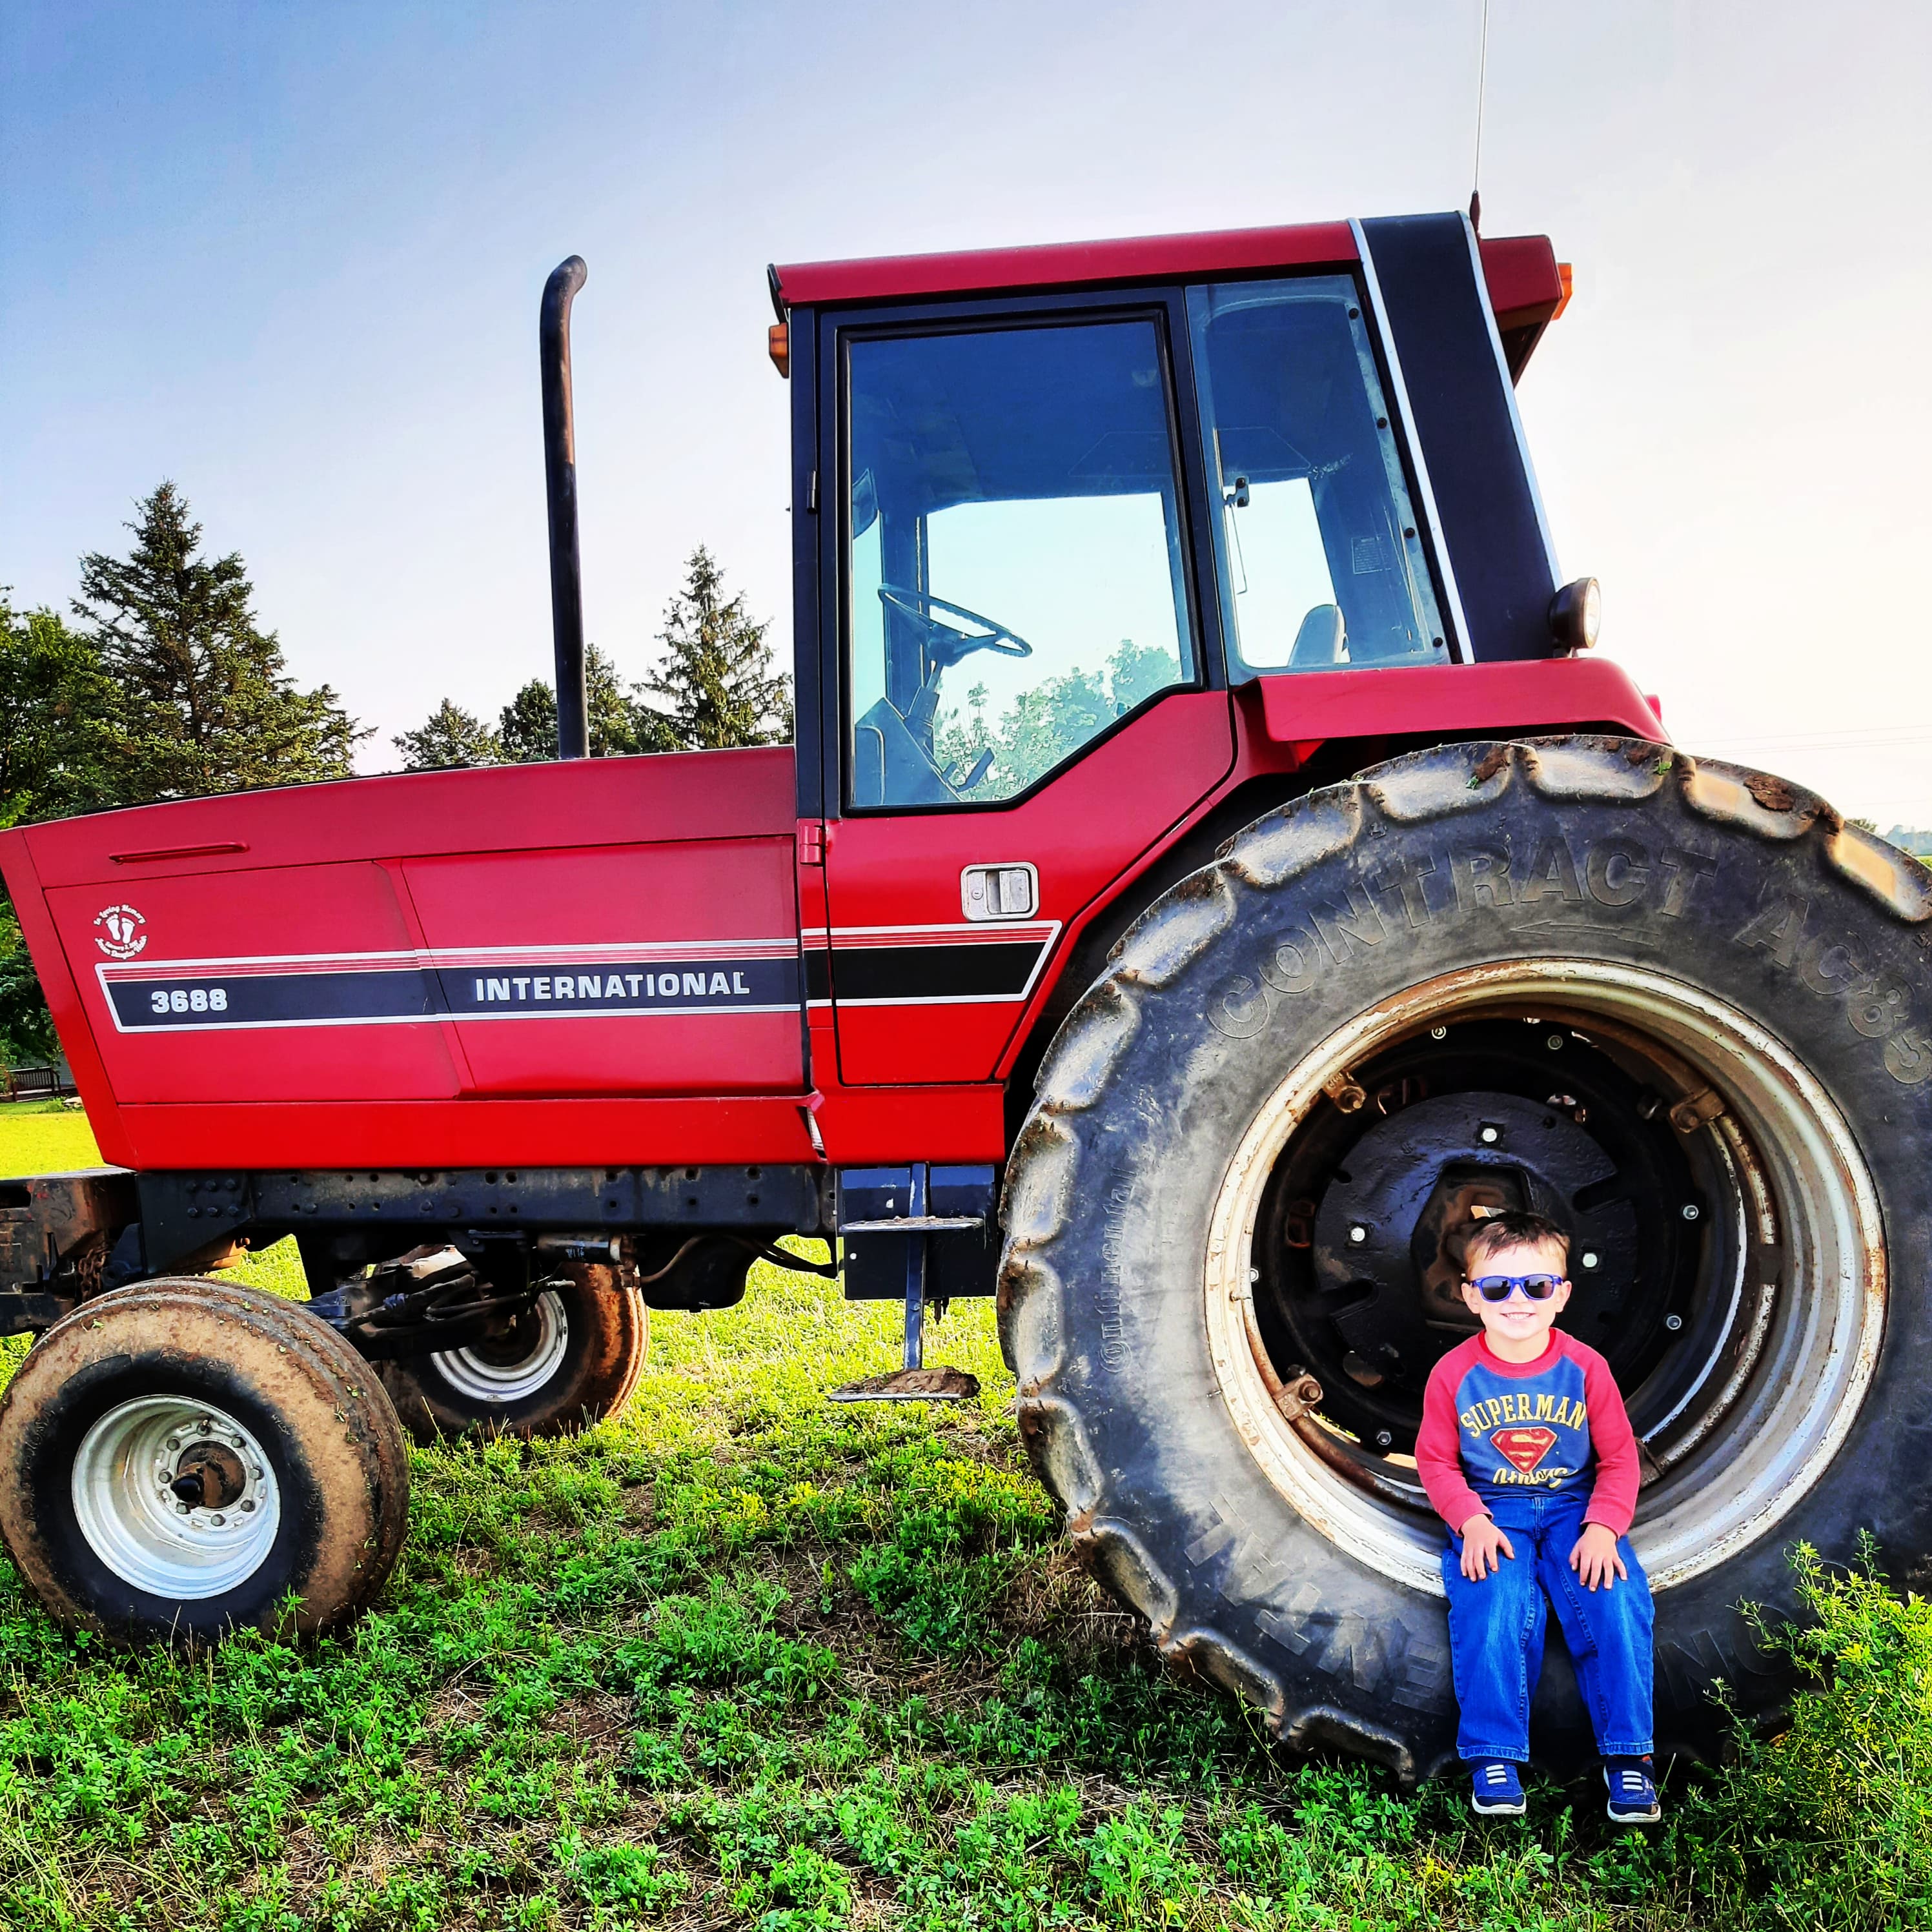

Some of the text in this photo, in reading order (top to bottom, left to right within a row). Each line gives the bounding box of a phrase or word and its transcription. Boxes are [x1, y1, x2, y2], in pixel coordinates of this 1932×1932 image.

[93, 904, 147, 926] In Loving Memory
[1206, 834, 1720, 1040] CONTRACT
[150, 988, 228, 1013] 3688
[475, 972, 751, 1002] INTERNATIONAL
[1460, 1393, 1587, 1438] SUPERMAN
